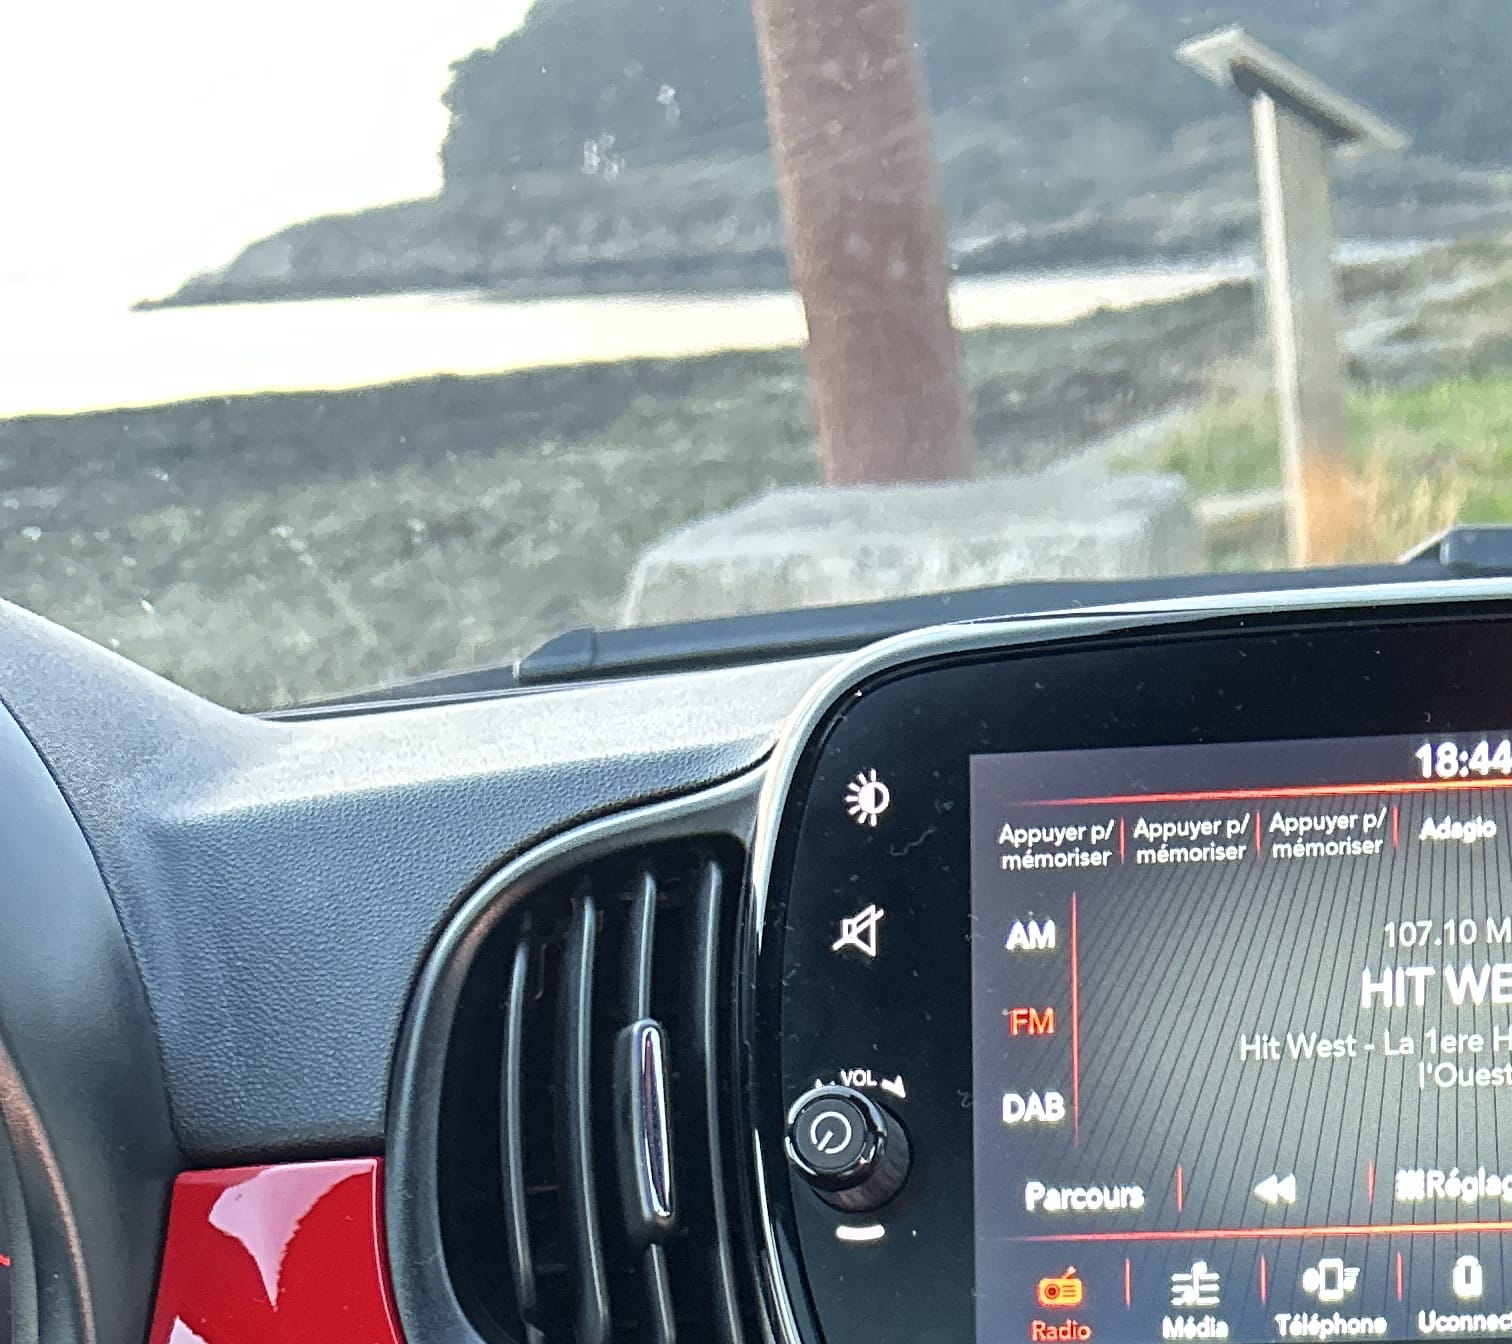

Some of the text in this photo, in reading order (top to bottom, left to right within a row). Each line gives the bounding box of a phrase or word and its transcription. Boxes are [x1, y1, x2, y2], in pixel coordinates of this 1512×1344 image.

[999, 819, 1116, 848] Appuyer p/
[1133, 813, 1250, 843] Appuyer p/
[1269, 807, 1387, 837] Appuyer p/
[1418, 816, 1497, 843] Adagio
[1001, 845, 1113, 872] mémoriser
[1136, 839, 1247, 866] mémoriser
[1272, 834, 1383, 861] mémoriser
[1005, 918, 1056, 951] AM
[1384, 919, 1477, 948] 107.10
[1361, 966, 1436, 1008] HIT
[1009, 1007, 1056, 1035] FM
[1240, 1034, 1281, 1060] Hit
[1287, 1032, 1357, 1059] West
[1384, 1031, 1415, 1056] La
[1424, 1029, 1485, 1056] 1ere
[840, 1070, 878, 1087] VOL
[1002, 1091, 1067, 1123] DAB
[1024, 1180, 1146, 1212] Parcours
[1031, 1319, 1092, 1343] Radio
[1162, 1315, 1230, 1339] Média
[1275, 1311, 1388, 1340] Téléphone
